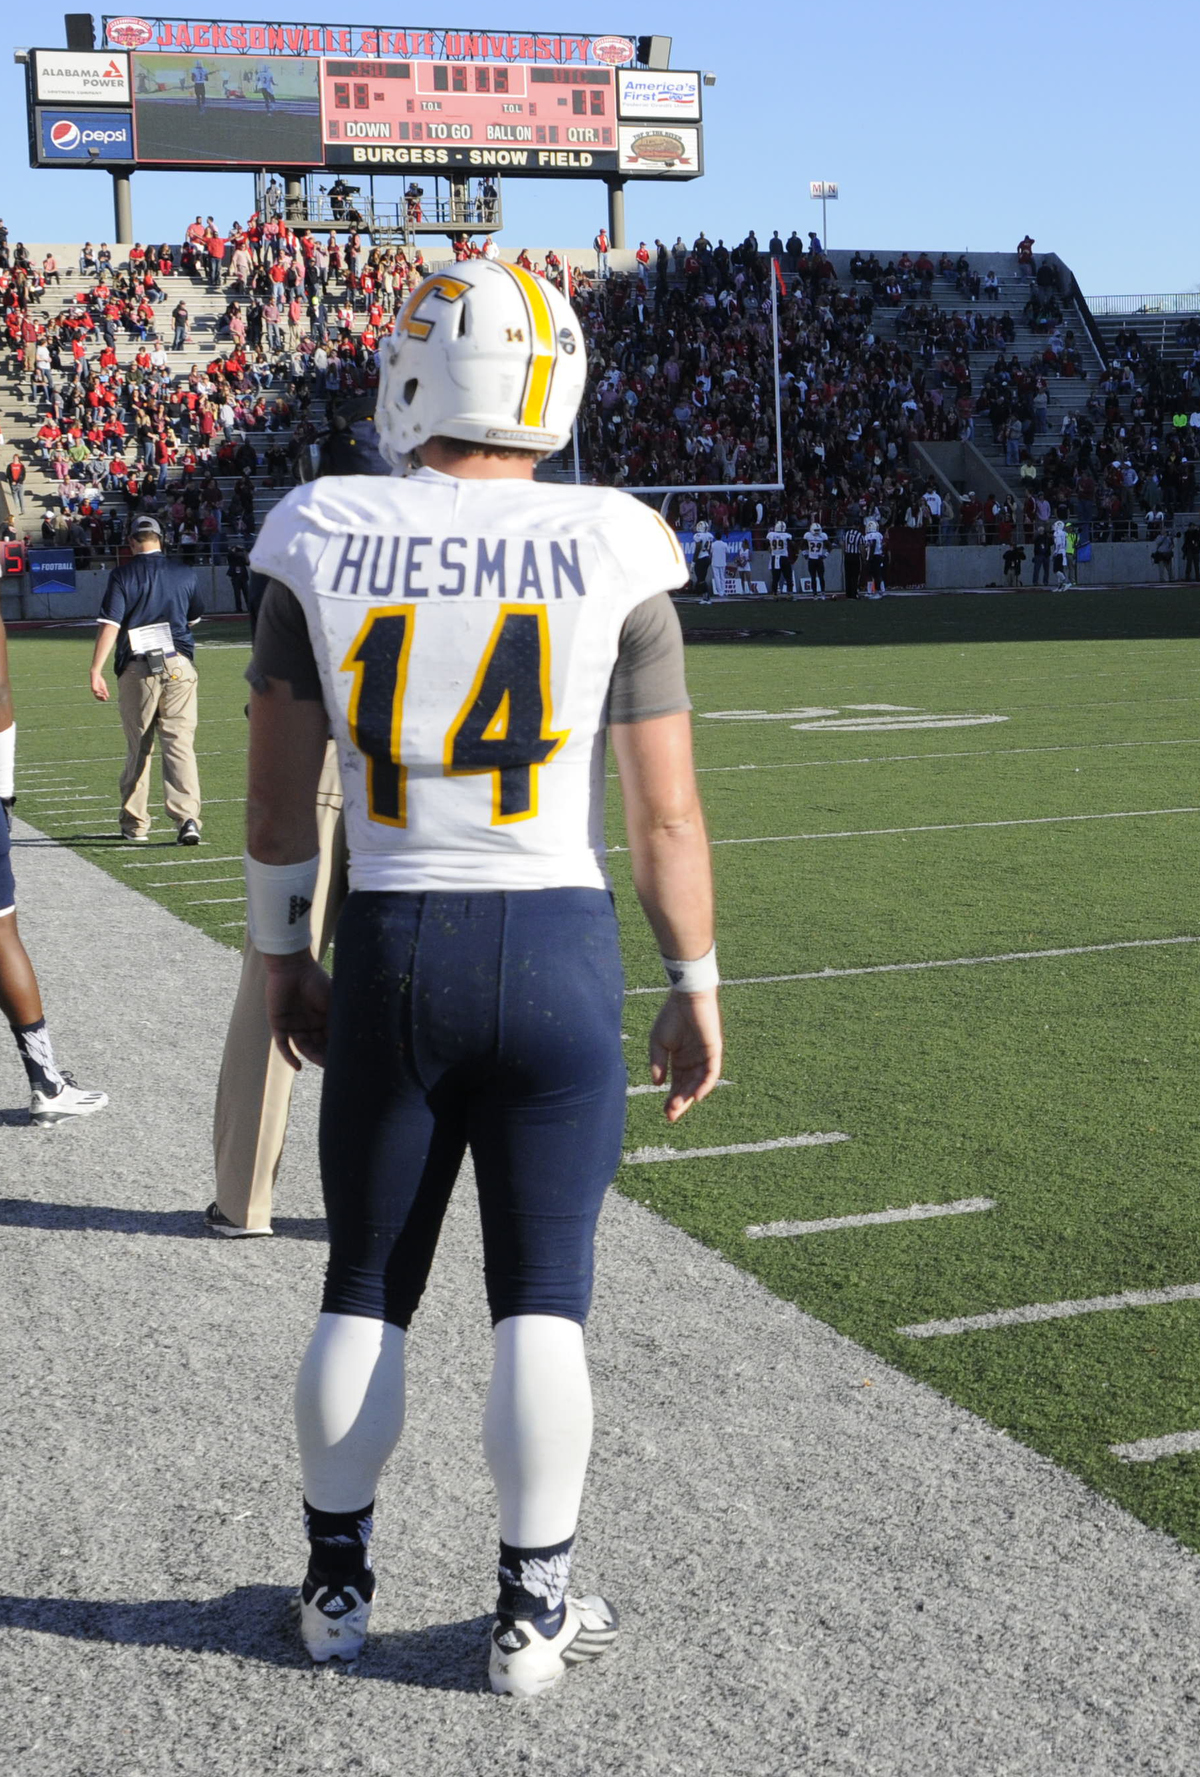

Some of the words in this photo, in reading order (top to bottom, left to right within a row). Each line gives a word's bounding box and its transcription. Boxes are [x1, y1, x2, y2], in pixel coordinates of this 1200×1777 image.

[157, 24, 350, 53] JACKSONVILLE
[361, 30, 435, 55] STATE
[445, 34, 590, 61] UNIVERSITY
[42, 68, 100, 78] ALABAMA
[350, 62, 387, 77] JSU
[83, 79, 125, 87] POWER
[452, 66, 508, 92] 9:05
[625, 81, 696, 92] America's
[335, 83, 369, 109] 28
[623, 91, 656, 101] First
[82, 128, 126, 144] pepsi
[346, 122, 390, 138] DOWN
[428, 124, 447, 138] TO
[451, 125, 470, 139] GO
[486, 125, 513, 140] BALL
[516, 126, 532, 140] ON
[568, 127, 598, 142] QTR.
[353, 147, 449, 163] BURGESS
[469, 150, 528, 165] SNOW
[539, 151, 593, 167] FIELD
[813, 184, 821, 193] M
[828, 184, 836, 193] N
[505, 328, 524, 343] 14
[771, 539, 784, 550] 99
[809, 542, 822, 552] 29
[5, 544, 23, 572] 5
[41, 562, 73, 571] FOOTBALL
[331, 533, 586, 599] HUESMAN
[338, 603, 572, 829] 14
